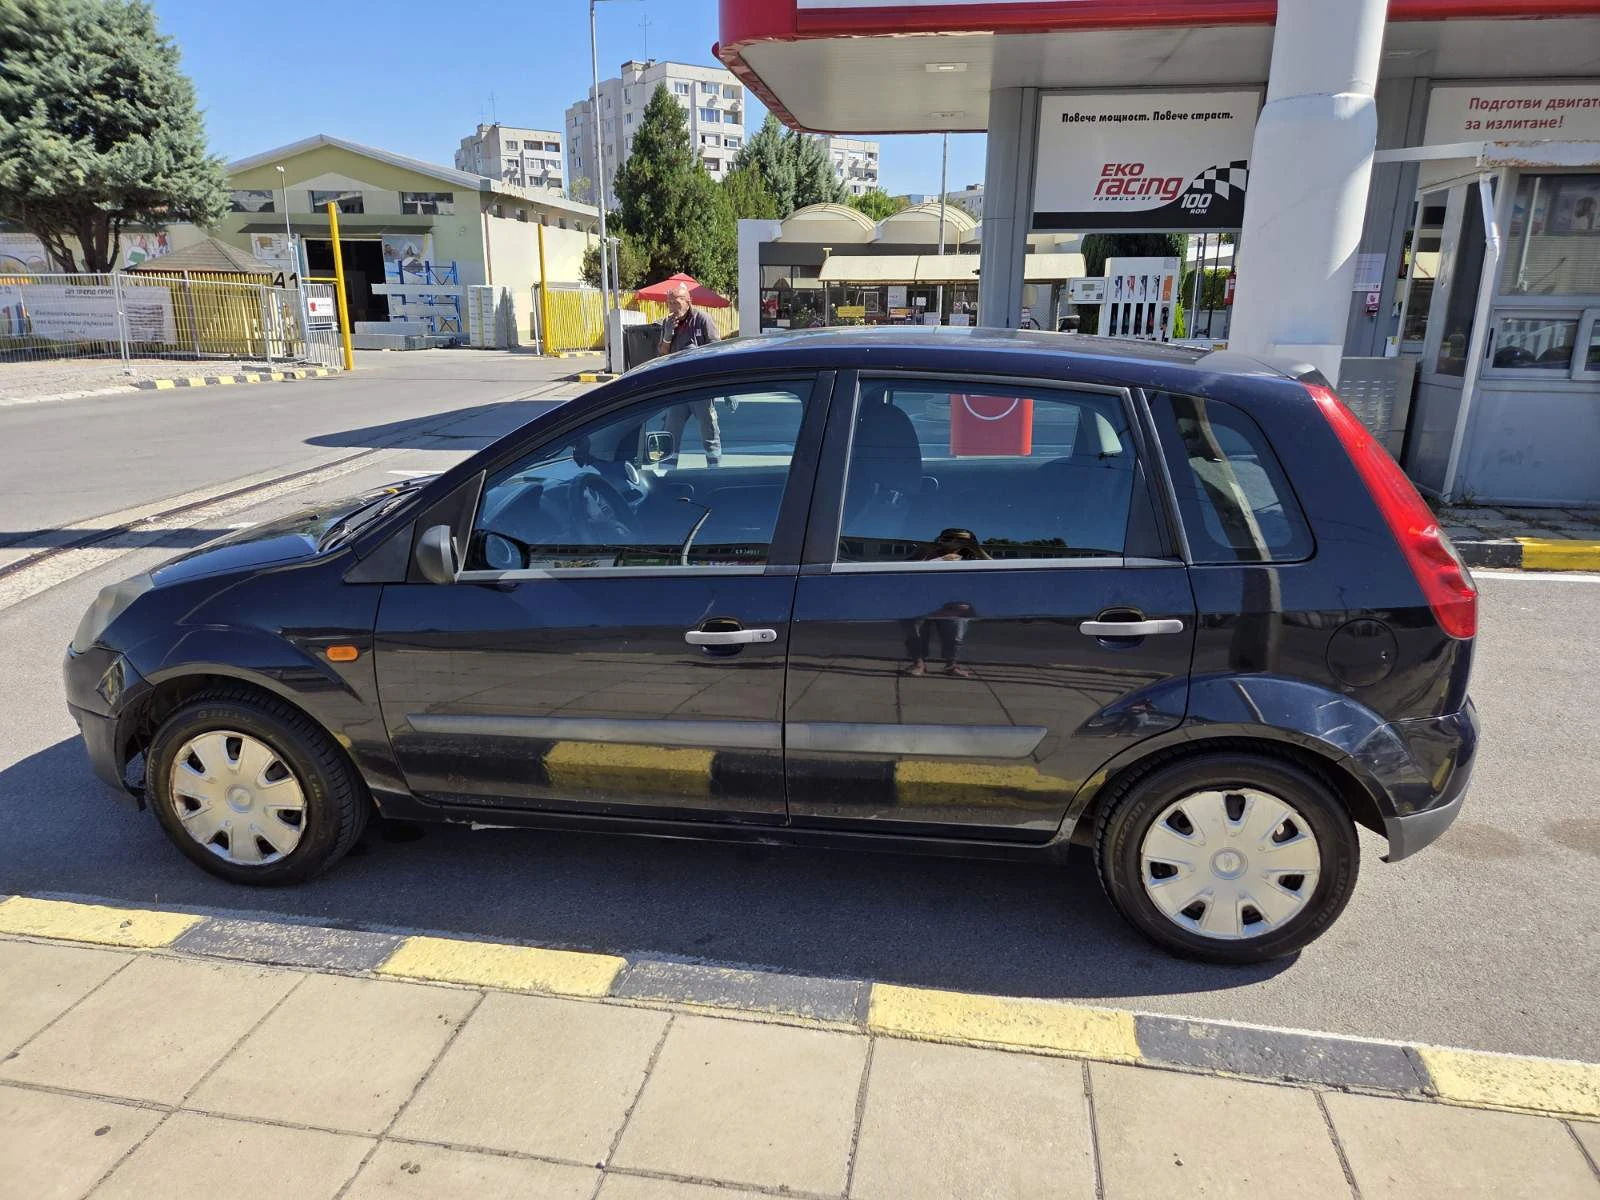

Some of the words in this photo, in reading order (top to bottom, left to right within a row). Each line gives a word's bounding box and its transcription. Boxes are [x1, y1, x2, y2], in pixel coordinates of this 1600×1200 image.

[1469, 97, 1541, 111] Подготви
[1545, 97, 1600, 111] двигат
[1062, 113, 1097, 123] Повече
[1099, 113, 1150, 123] мощност.
[1153, 111, 1188, 121] Повече
[1191, 111, 1234, 121] страст.
[1464, 120, 1481, 130] за
[1486, 115, 1564, 130] излитане!
[1101, 163, 1145, 177] EKO
[1095, 177, 1184, 201] racing
[1181, 193, 1213, 209] 100
